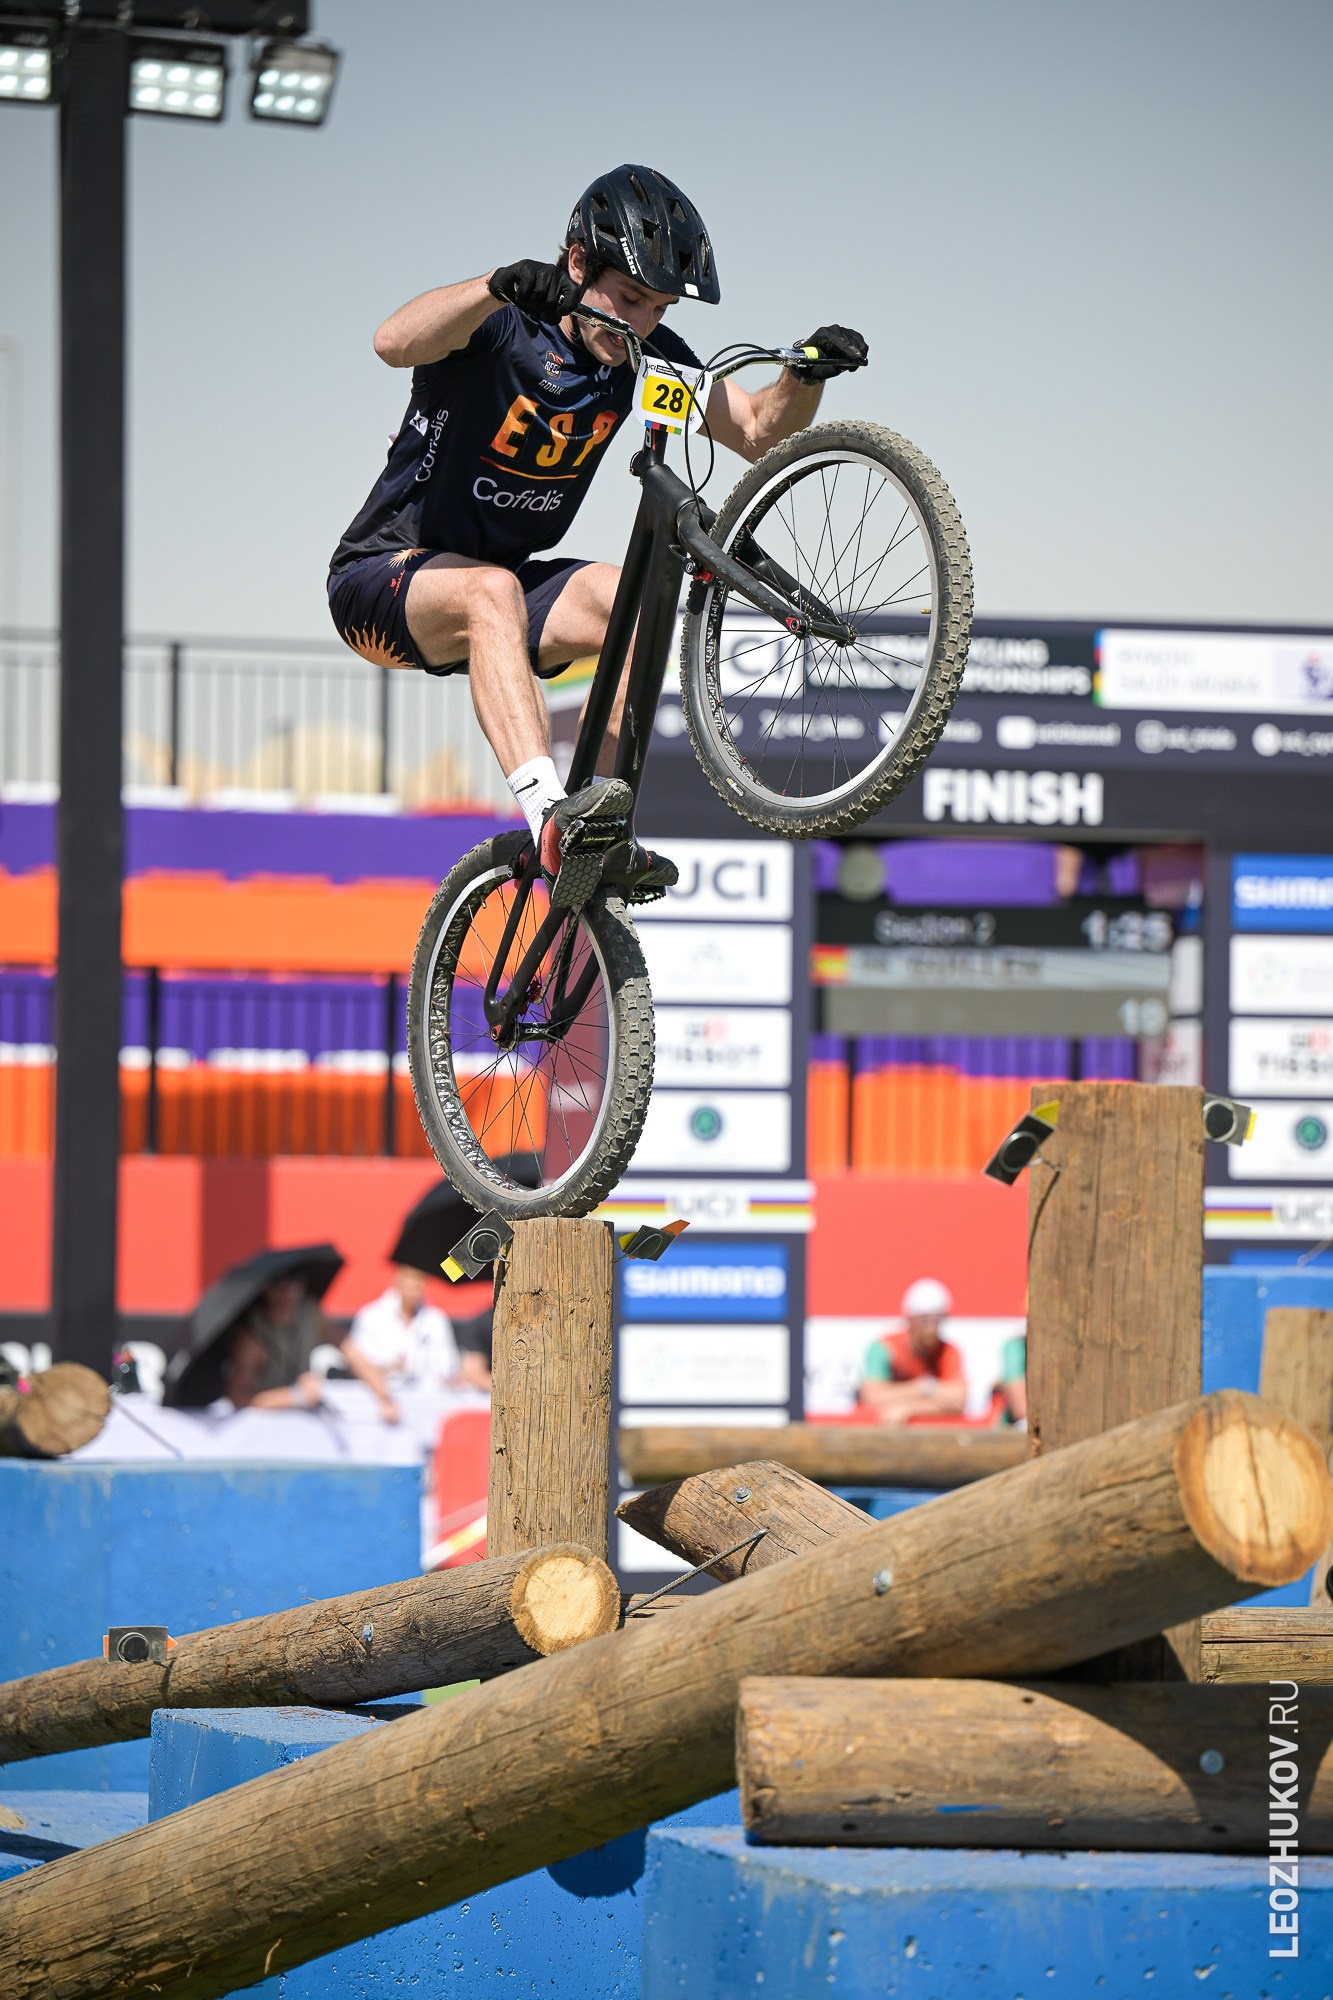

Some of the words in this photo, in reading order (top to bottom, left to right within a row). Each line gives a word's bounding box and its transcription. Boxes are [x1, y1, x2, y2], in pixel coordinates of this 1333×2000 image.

[652, 383, 685, 414] 28
[489, 394, 619, 468] ESP
[472, 476, 564, 512] Cofidis
[923, 768, 1104, 825] FINISH
[624, 1265, 787, 1298] SHIMANO
